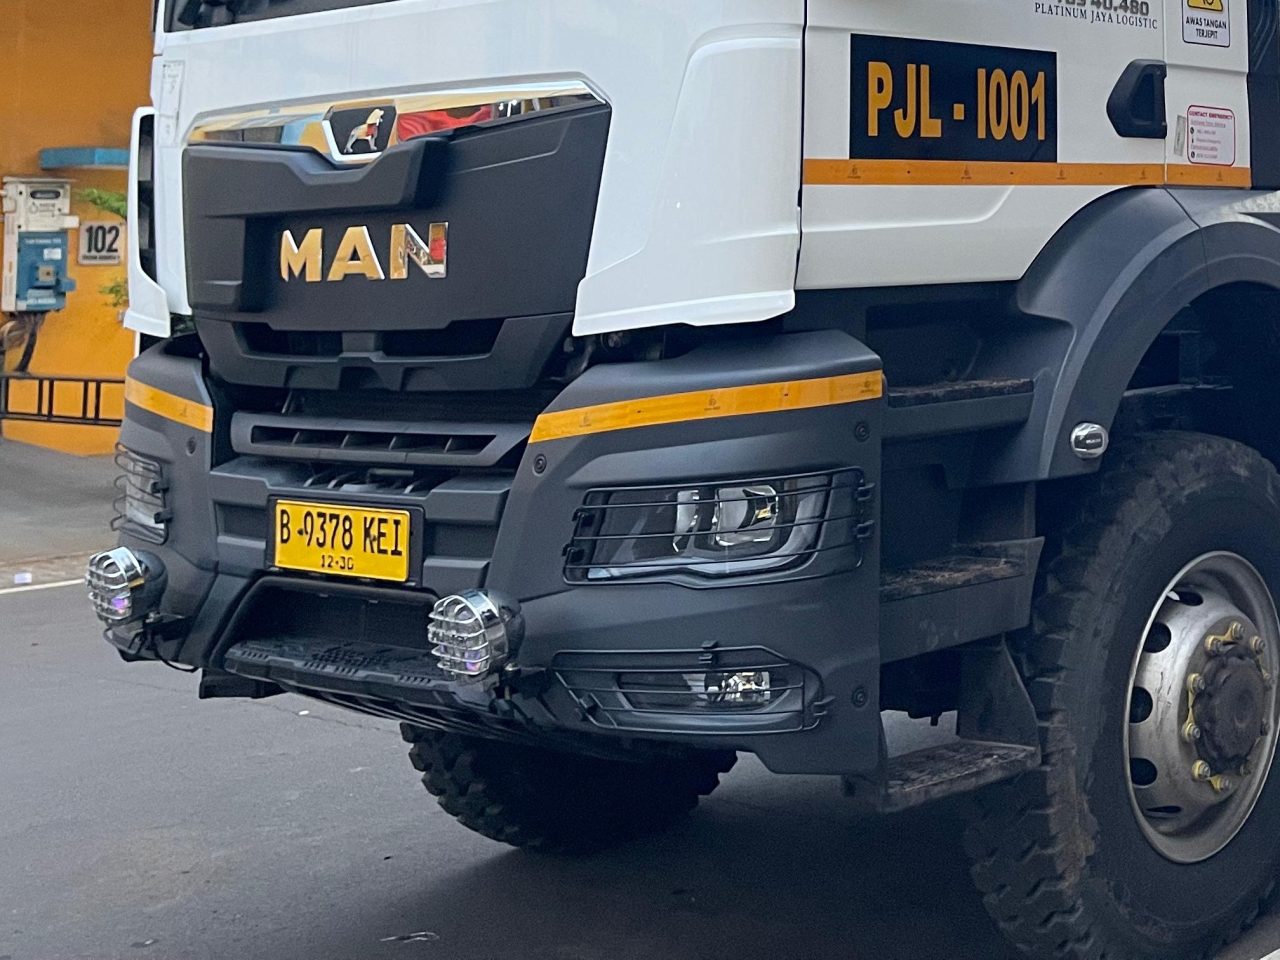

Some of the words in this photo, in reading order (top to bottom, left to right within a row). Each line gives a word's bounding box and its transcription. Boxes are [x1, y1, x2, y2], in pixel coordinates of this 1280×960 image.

[1035, 2, 1087, 20] PLATINUM
[1090, 10, 1113, 24] JAYA
[1116, 14, 1158, 30] LOGISTIC
[1186, 16, 1202, 27] AWAS
[1203, 18, 1227, 30] TANGAN
[1196, 28, 1218, 40] TERJEPIT
[867, 61, 942, 139] PJL
[86, 225, 120, 253] 102
[279, 221, 449, 283] MAN
[280, 509, 291, 544] B
[303, 511, 353, 551] 9378
[363, 516, 403, 557] KEI
